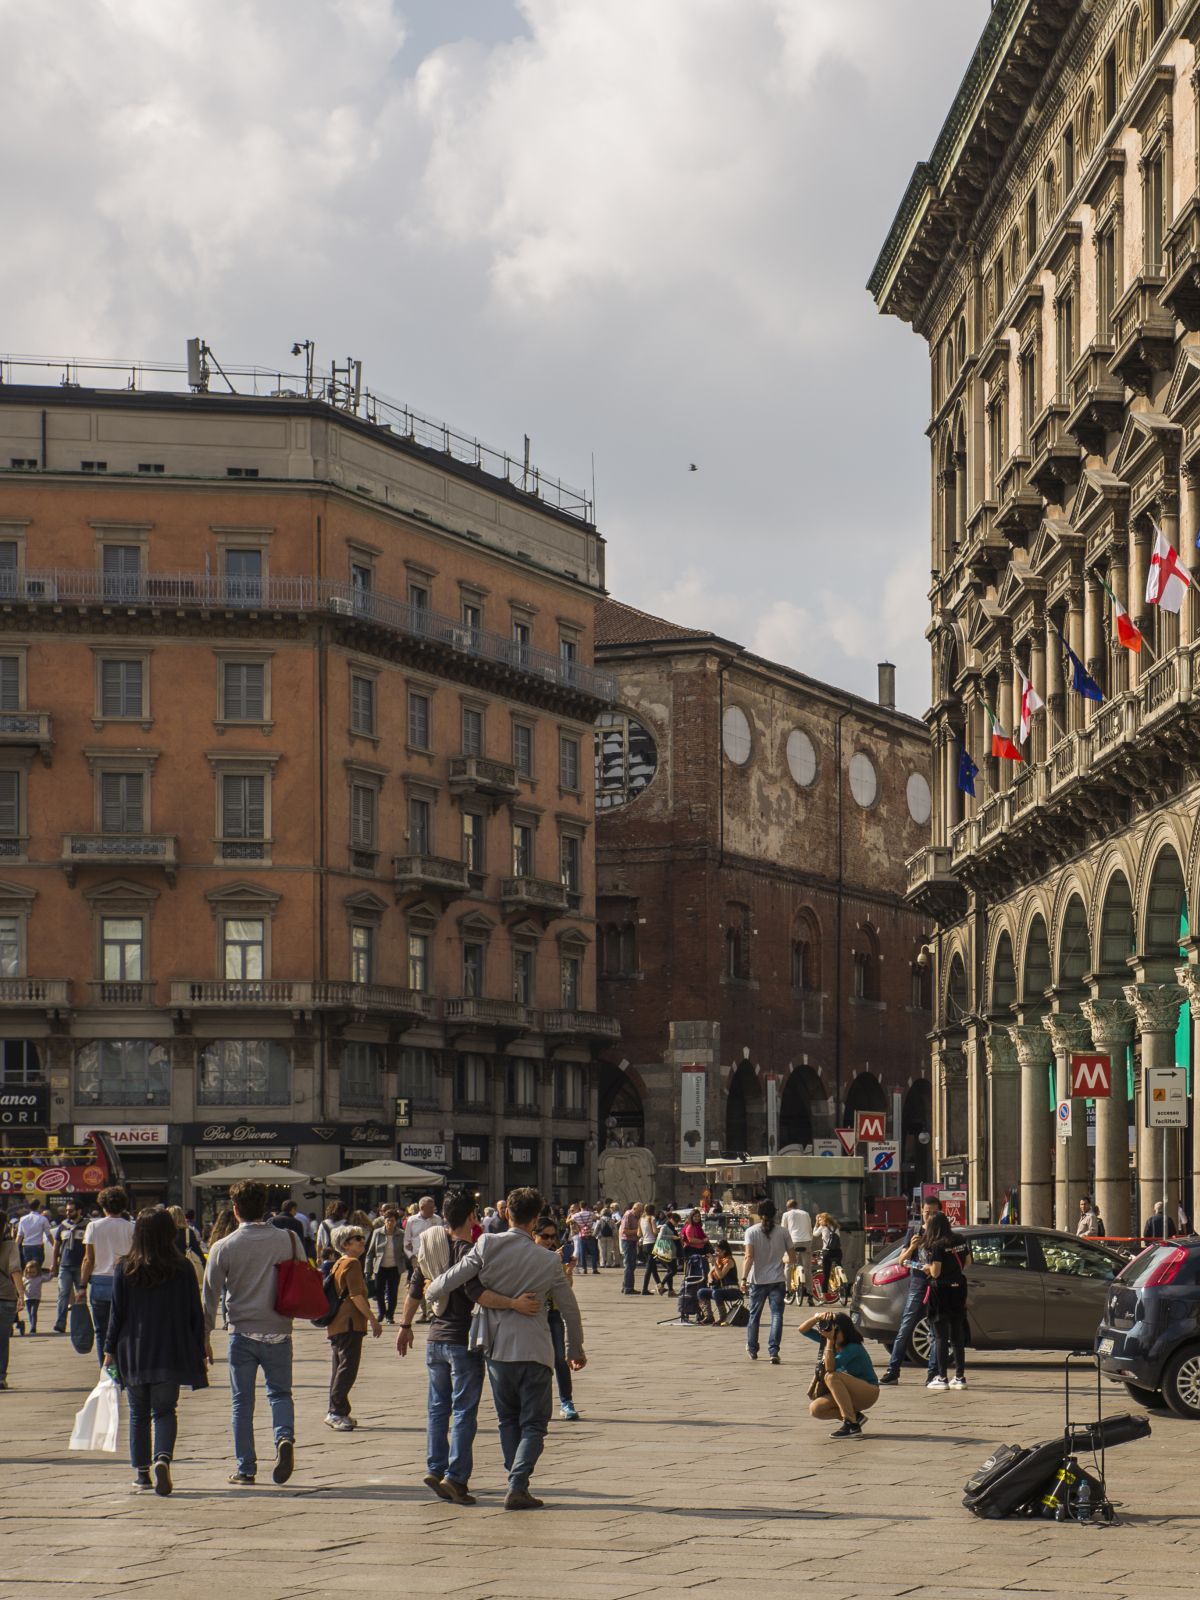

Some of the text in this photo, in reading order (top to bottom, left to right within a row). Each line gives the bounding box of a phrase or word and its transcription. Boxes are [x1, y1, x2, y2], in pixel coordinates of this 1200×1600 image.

[1074, 1063, 1109, 1089] M
[397, 1099, 408, 1115] T
[202, 1125, 278, 1141] Bar Duomo
[860, 1119, 883, 1136] M
[109, 1132, 159, 1142] HANGE
[403, 1145, 432, 1159] change
[945, 1208, 961, 1217] IVA
